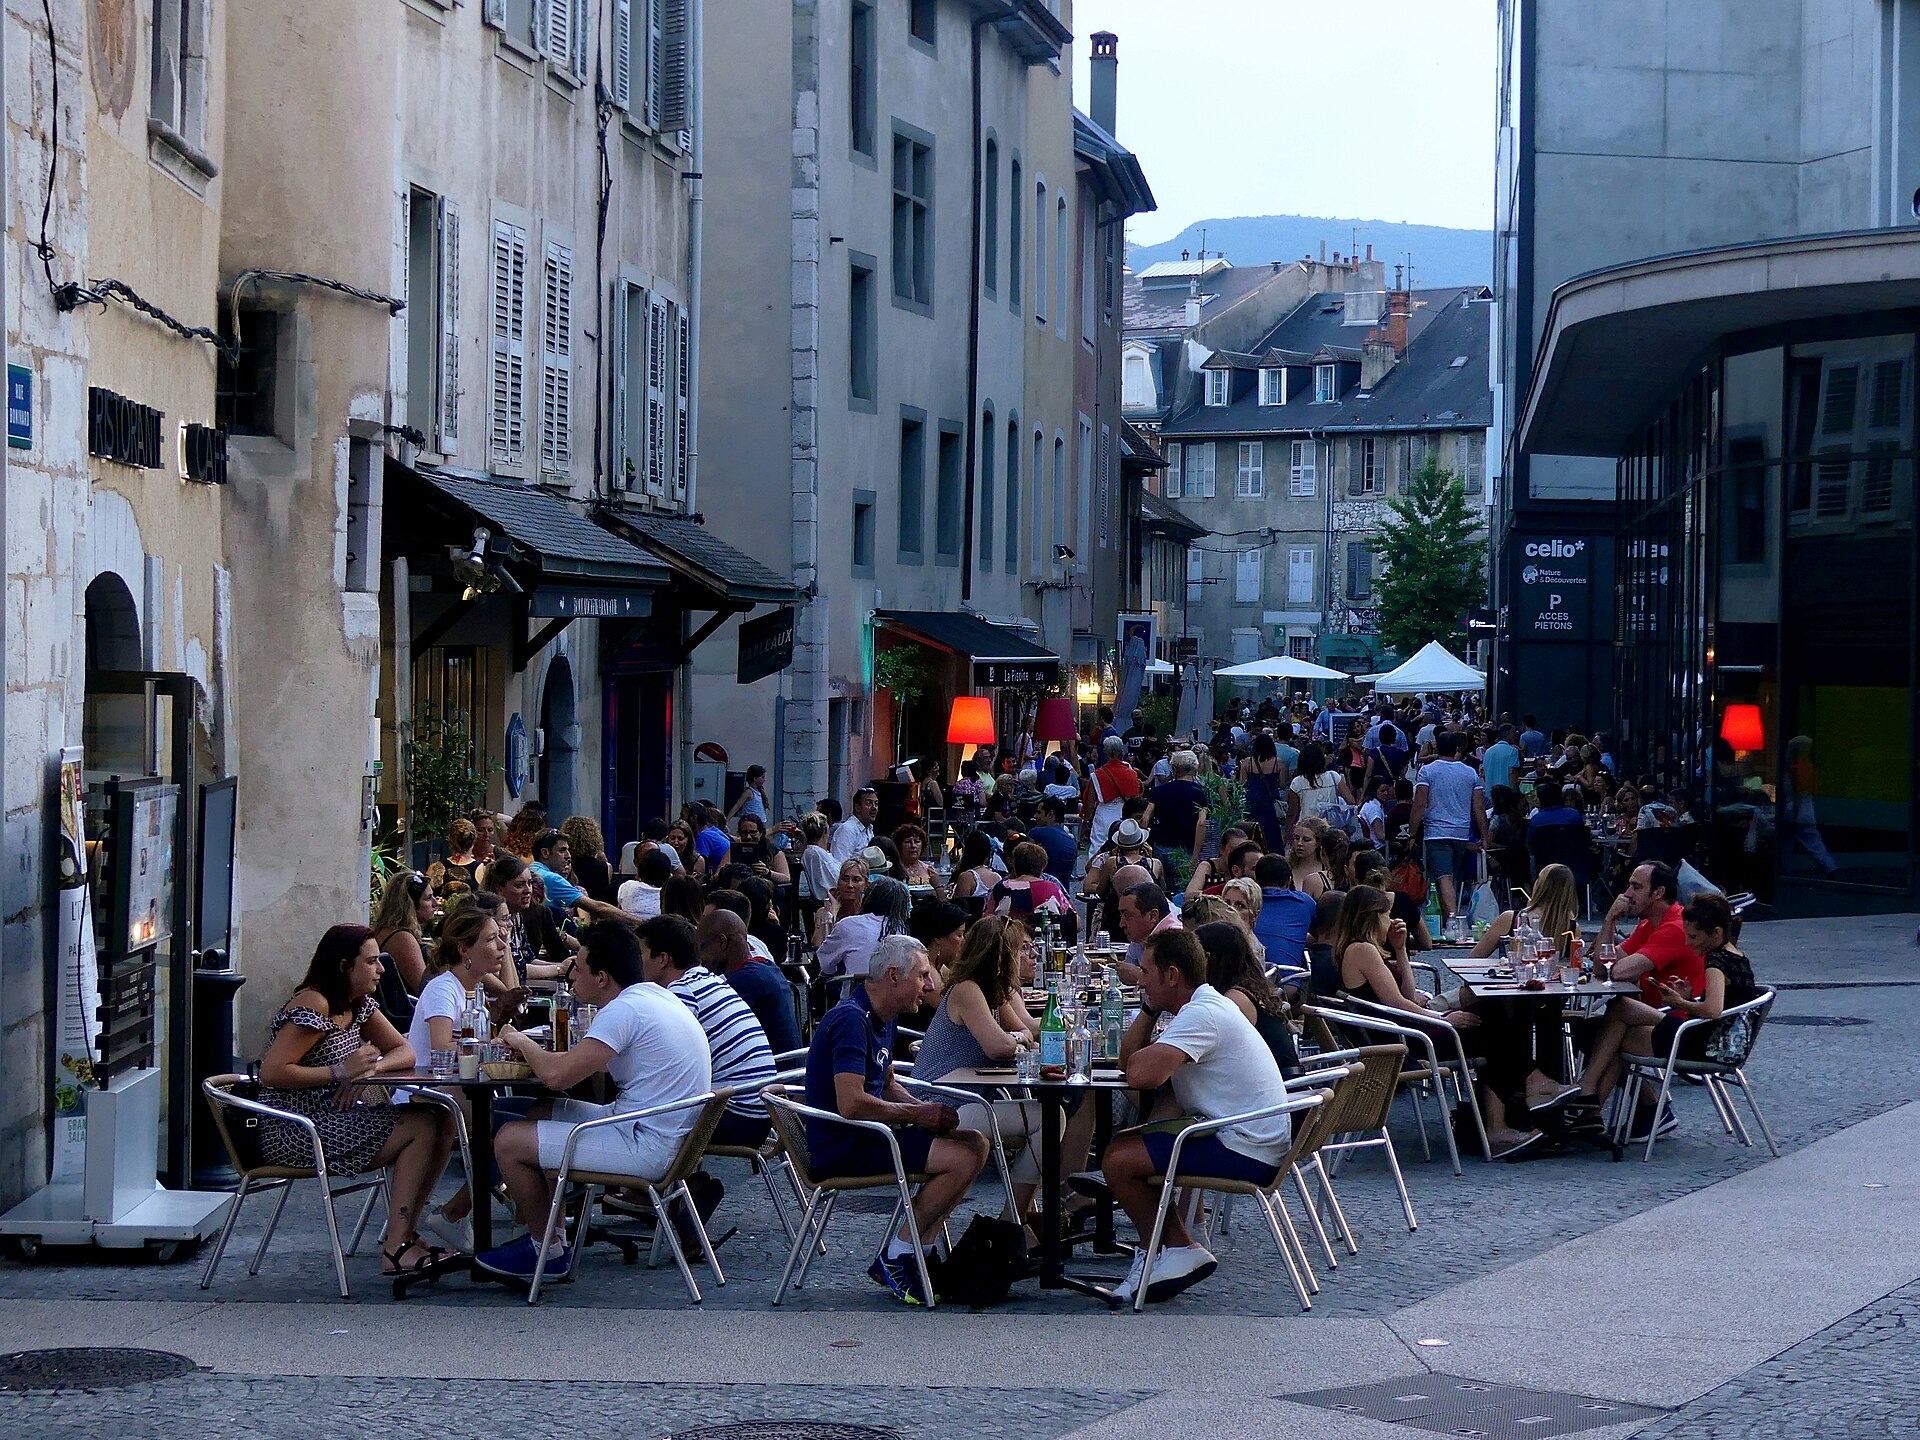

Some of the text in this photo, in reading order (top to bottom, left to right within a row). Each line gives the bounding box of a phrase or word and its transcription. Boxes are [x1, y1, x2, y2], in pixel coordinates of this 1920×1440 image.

[88, 386, 165, 469] RISTORANTE
[1545, 576, 1587, 584] Découvertes
[1549, 594, 1562, 610] P
[1538, 612, 1569, 621] ACCES
[1534, 621, 1573, 630] PIETONS
